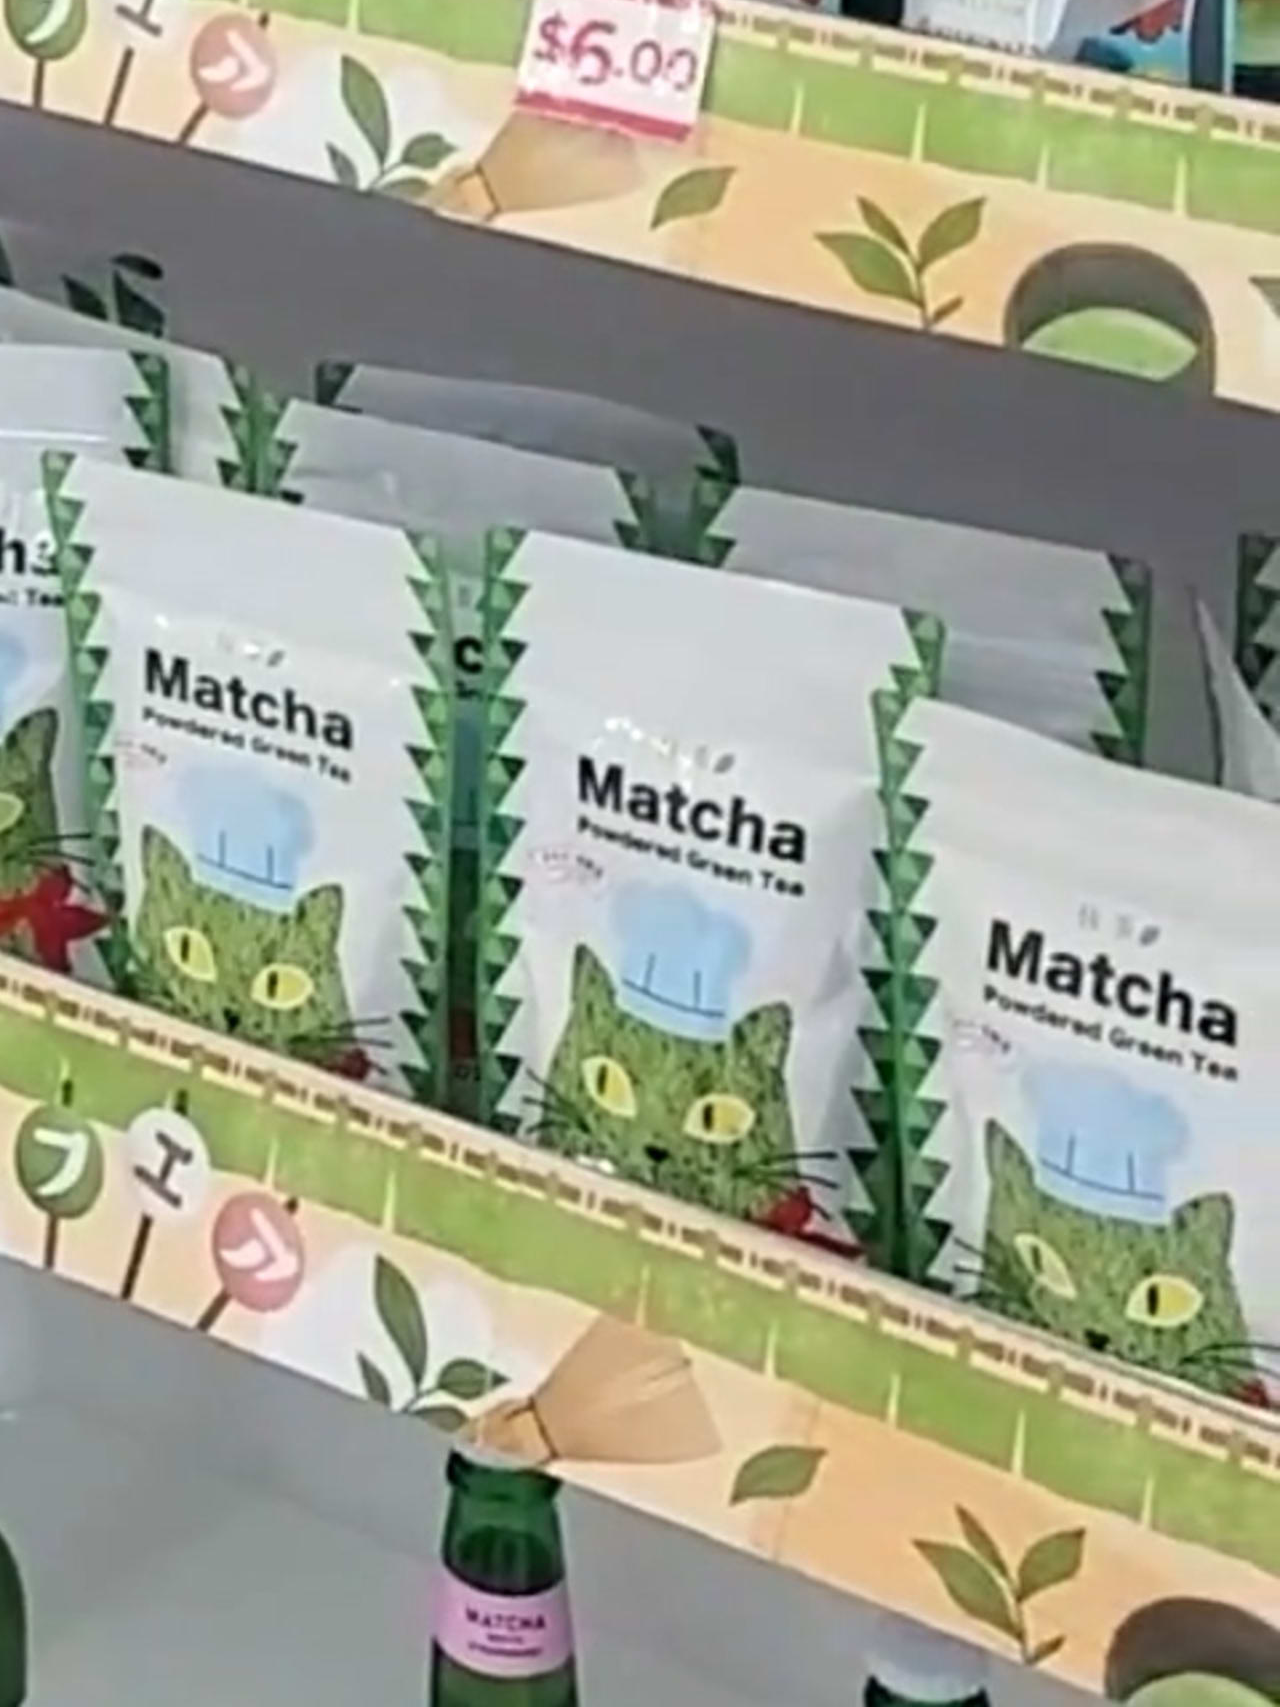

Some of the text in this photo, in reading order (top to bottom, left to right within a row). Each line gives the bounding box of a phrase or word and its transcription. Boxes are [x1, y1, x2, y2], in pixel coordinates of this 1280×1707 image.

[532, 10, 699, 92] $6.00
[144, 647, 356, 753] Matcha
[576, 755, 809, 868] Matcha
[985, 917, 1240, 1050] Matcha
[1107, 1022, 1184, 1065] Green
